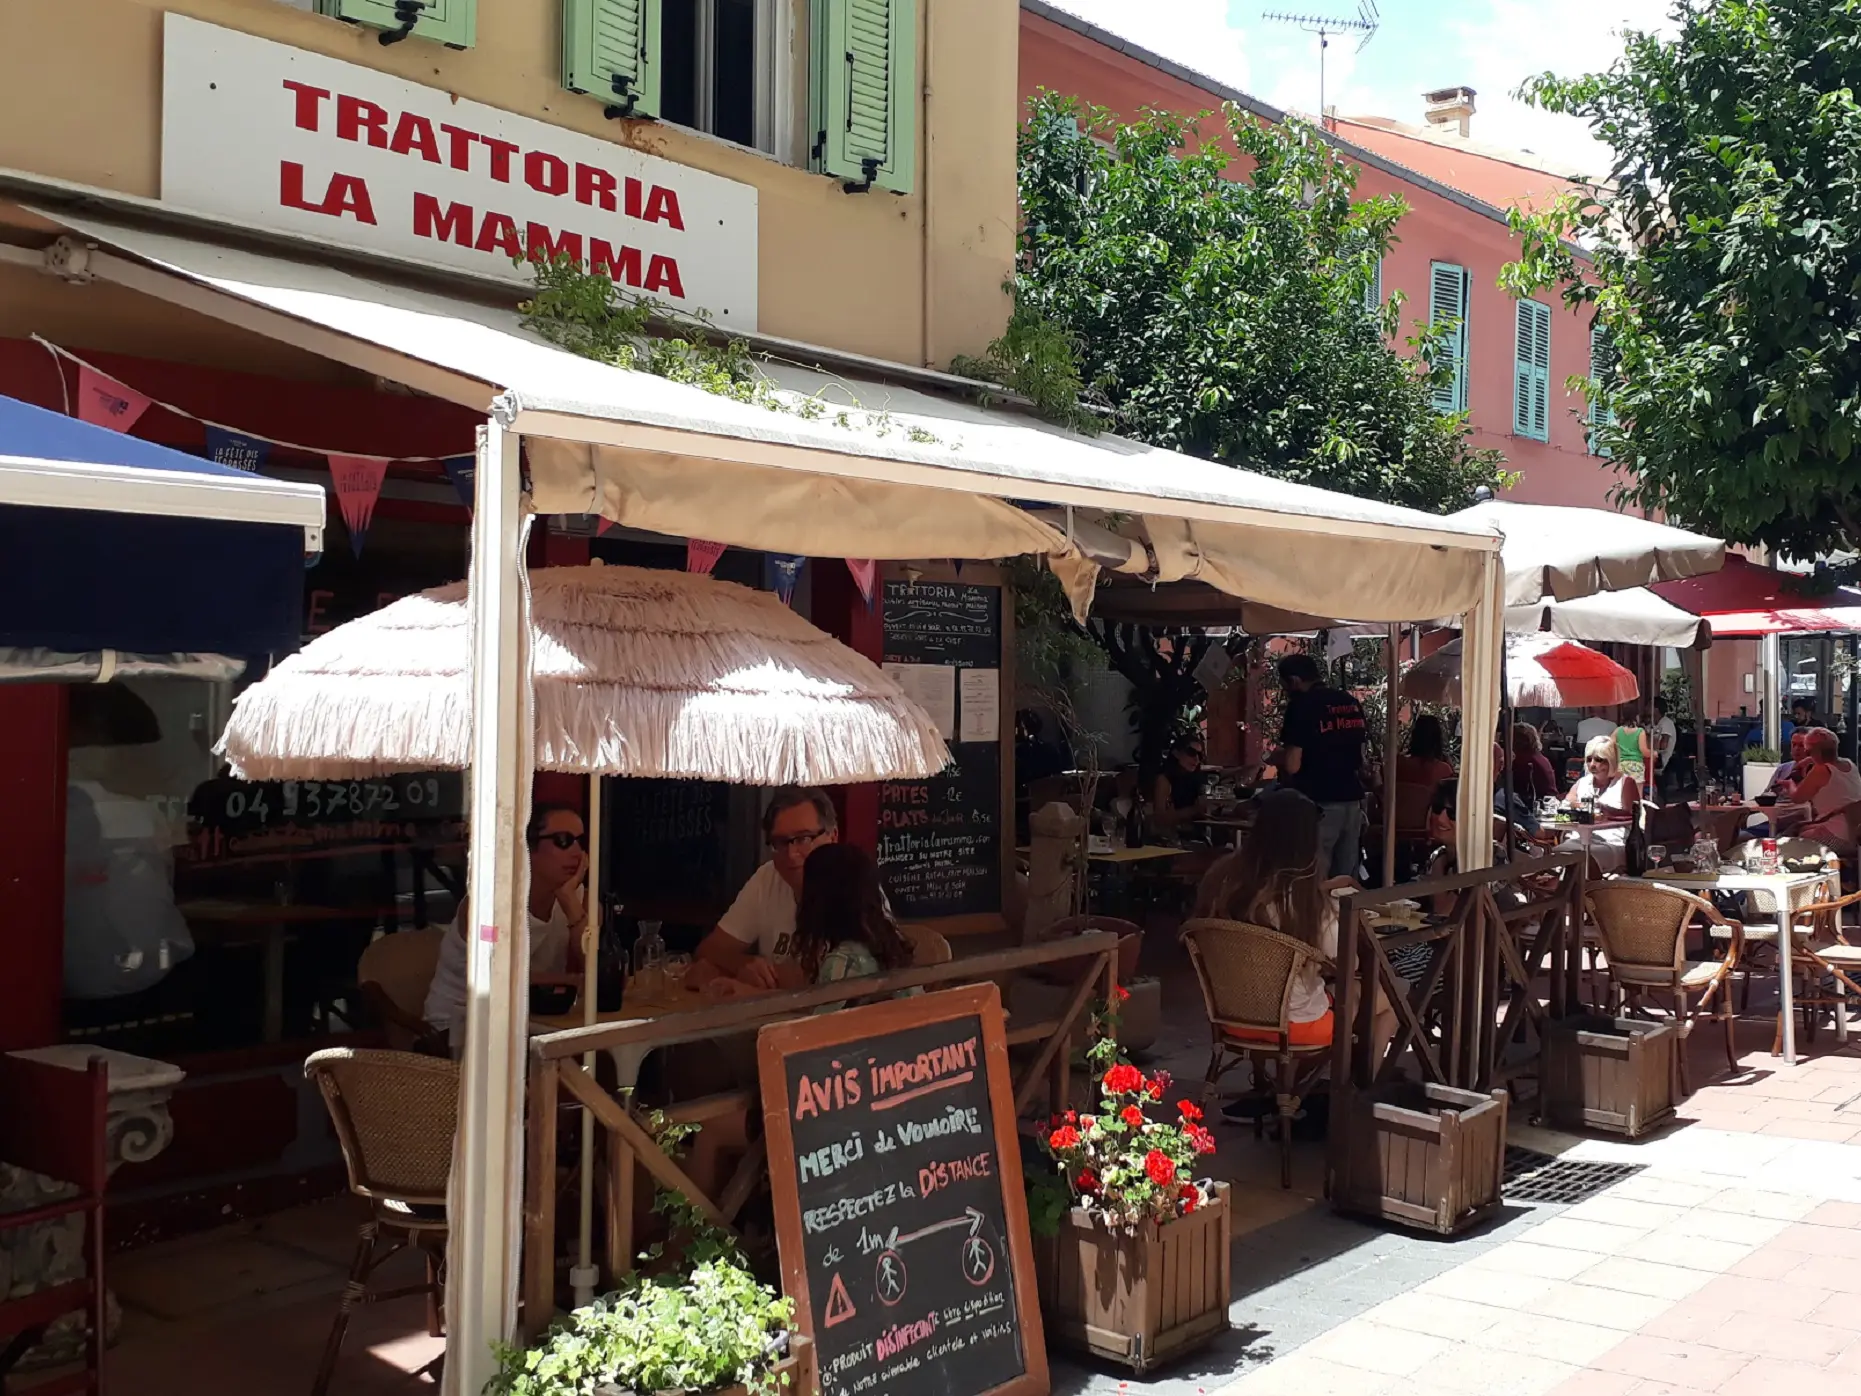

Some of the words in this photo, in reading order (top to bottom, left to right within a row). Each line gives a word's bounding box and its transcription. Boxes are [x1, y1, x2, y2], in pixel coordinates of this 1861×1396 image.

[283, 79, 685, 232] TRATTORIA
[280, 160, 378, 225] LA
[413, 191, 686, 299] MAMMA
[887, 584, 956, 599] TRATTORIA
[225, 788, 269, 826] 04
[406, 778, 439, 808] 09
[882, 783, 929, 805] PATES
[882, 808, 929, 828] PLATS
[795, 1060, 861, 1120] AVIS
[868, 1036, 977, 1096] IMPORTANT
[800, 1132, 864, 1183] MERCI
[874, 1130, 896, 1154] de
[803, 1184, 897, 1235] RESPECTEZ
[899, 1181, 916, 1199] la
[918, 1152, 991, 1199] DISTANCE
[822, 1244, 845, 1268] de
[832, 1342, 874, 1374] PRODUIT
